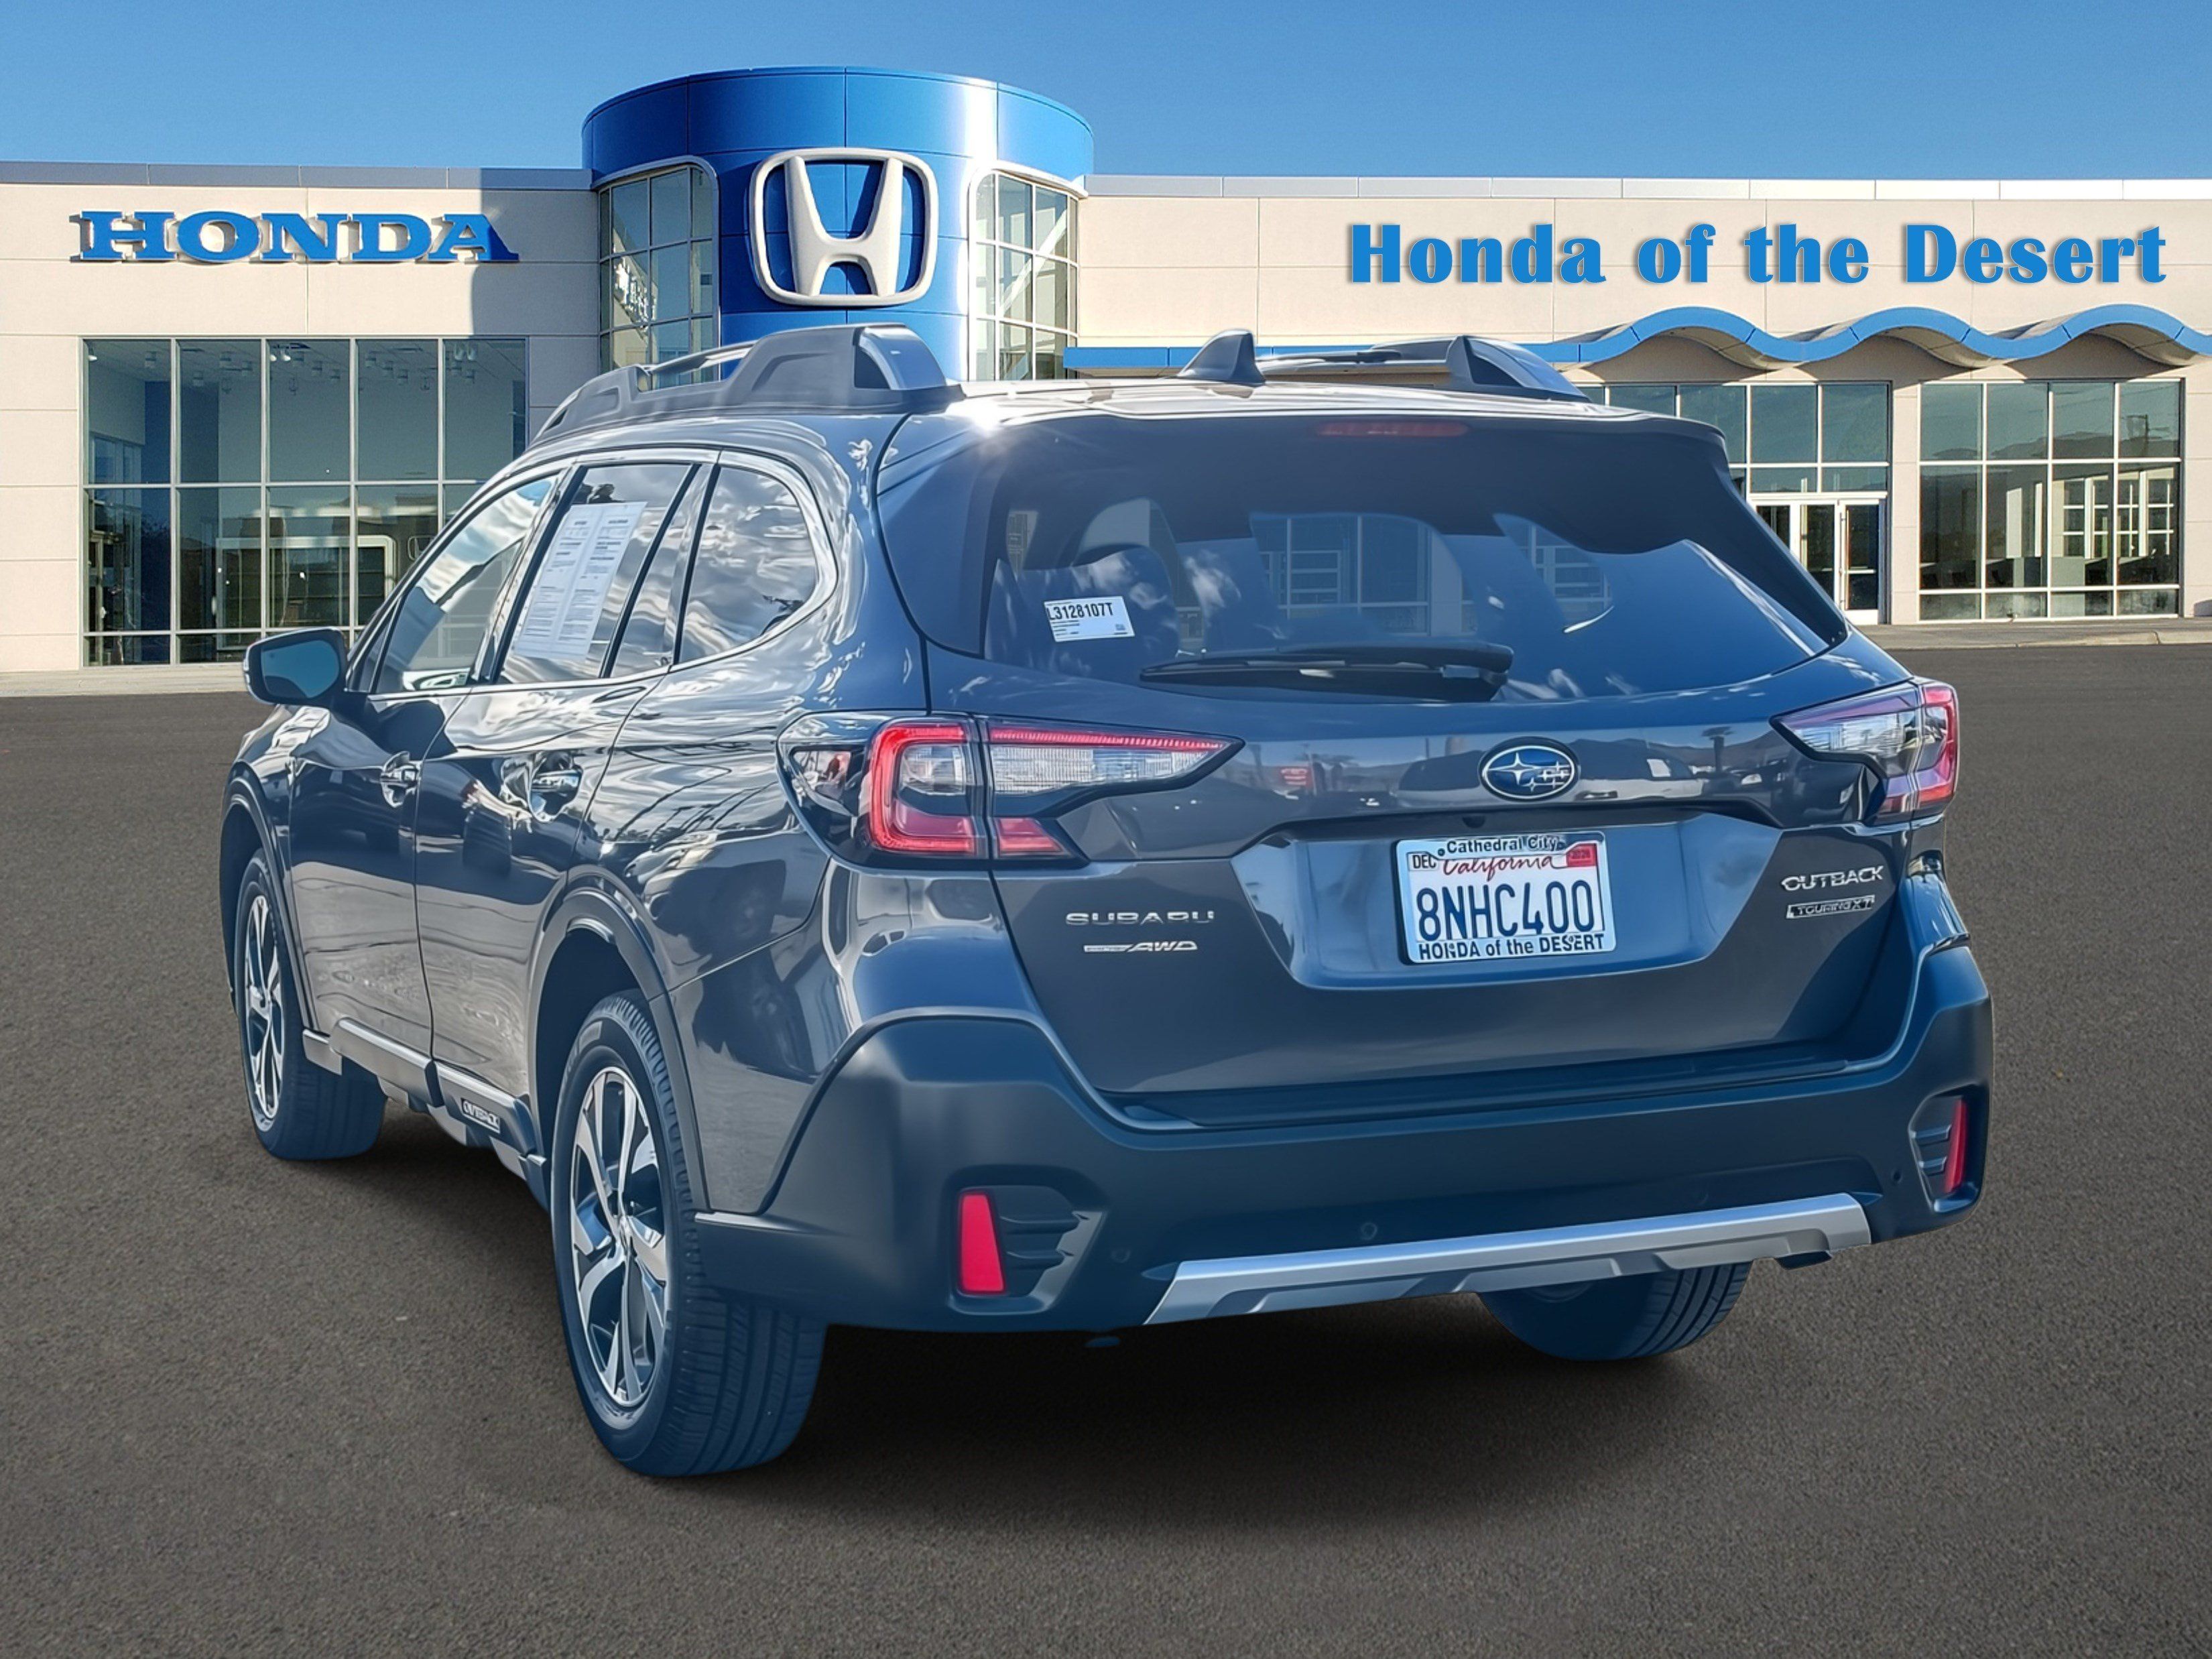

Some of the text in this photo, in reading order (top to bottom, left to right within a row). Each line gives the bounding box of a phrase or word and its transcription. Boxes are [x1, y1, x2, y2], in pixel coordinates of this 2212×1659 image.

[74, 210, 519, 263] HONDA
[1351, 223, 2167, 284] Honda of the Desert
[1046, 602, 1113, 620] L3128107T
[1447, 835, 1560, 853] Cathedral City
[1412, 855, 1437, 869] DEC
[1443, 855, 1555, 881] California
[1781, 865, 1884, 891] OUTBACK
[1066, 910, 1215, 926] SUBARU
[1416, 879, 1595, 942] 8NHC400
[1127, 940, 1198, 953] AWD
[1419, 933, 1604, 960] HONDA of the DESERT
